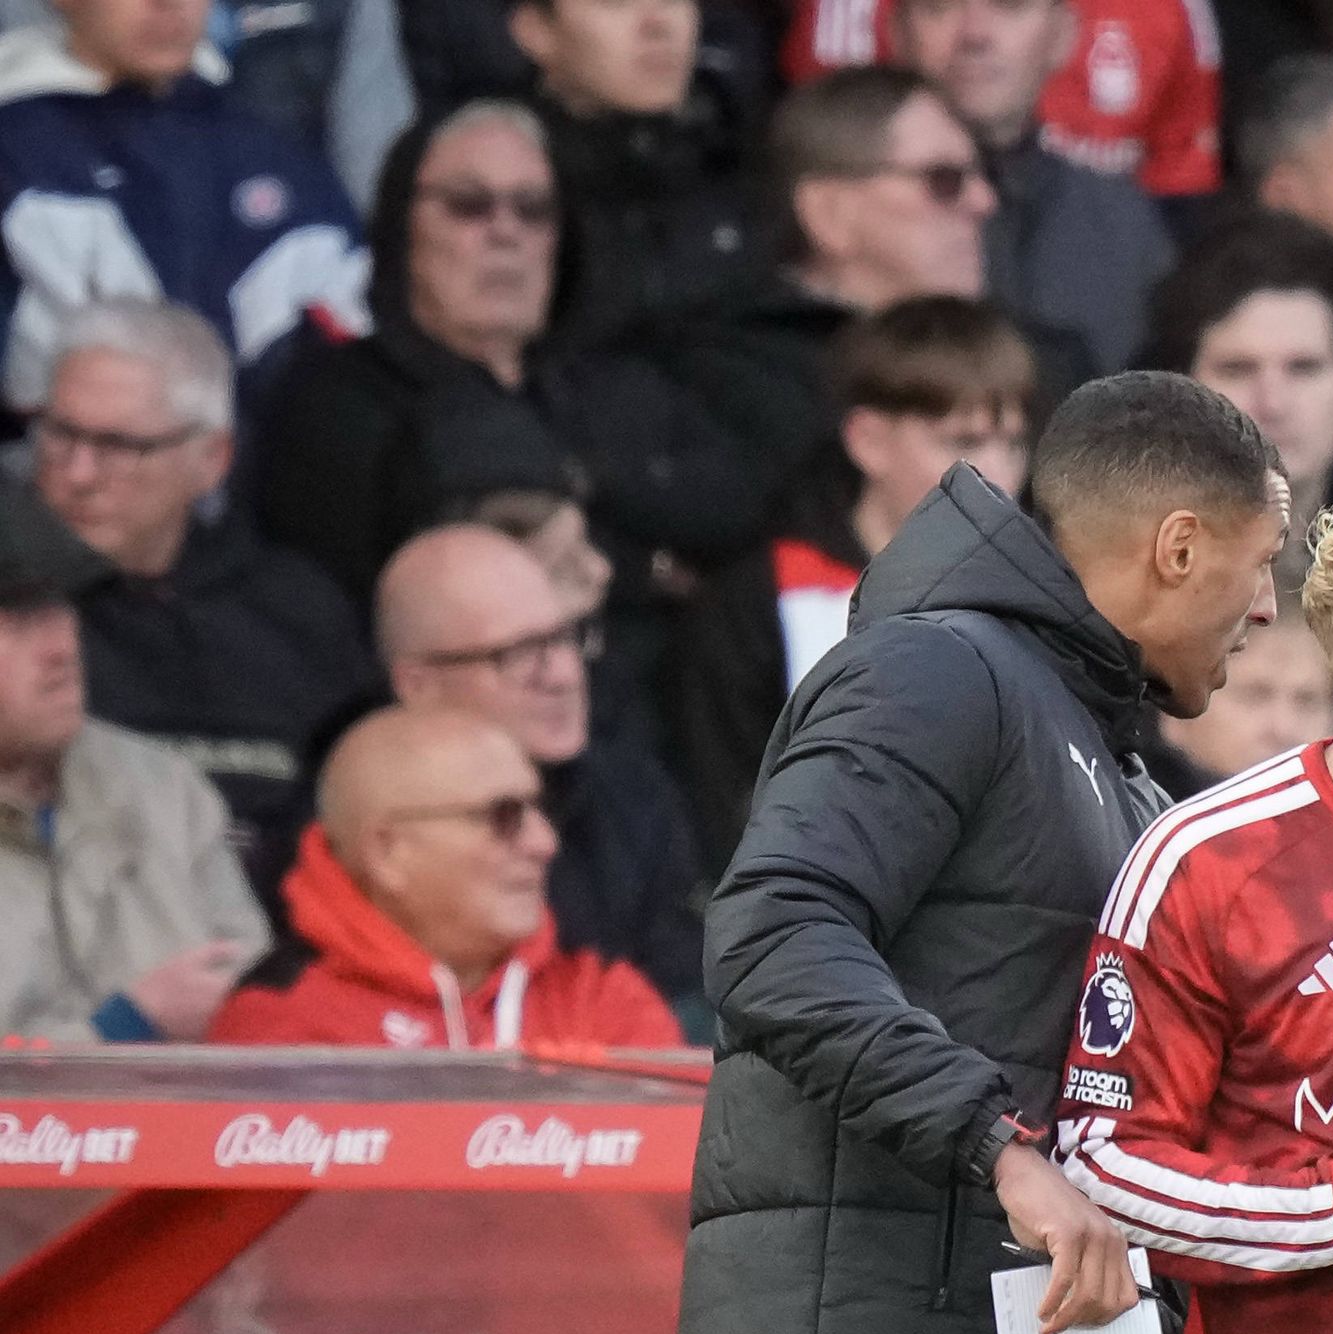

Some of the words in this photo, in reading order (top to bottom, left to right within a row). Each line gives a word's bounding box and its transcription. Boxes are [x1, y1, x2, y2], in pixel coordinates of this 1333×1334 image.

[1076, 1086, 1132, 1111] racism
[1080, 1070, 1127, 1093] room
[214, 1112, 335, 1177] Bally
[465, 1113, 588, 1179] Bally
